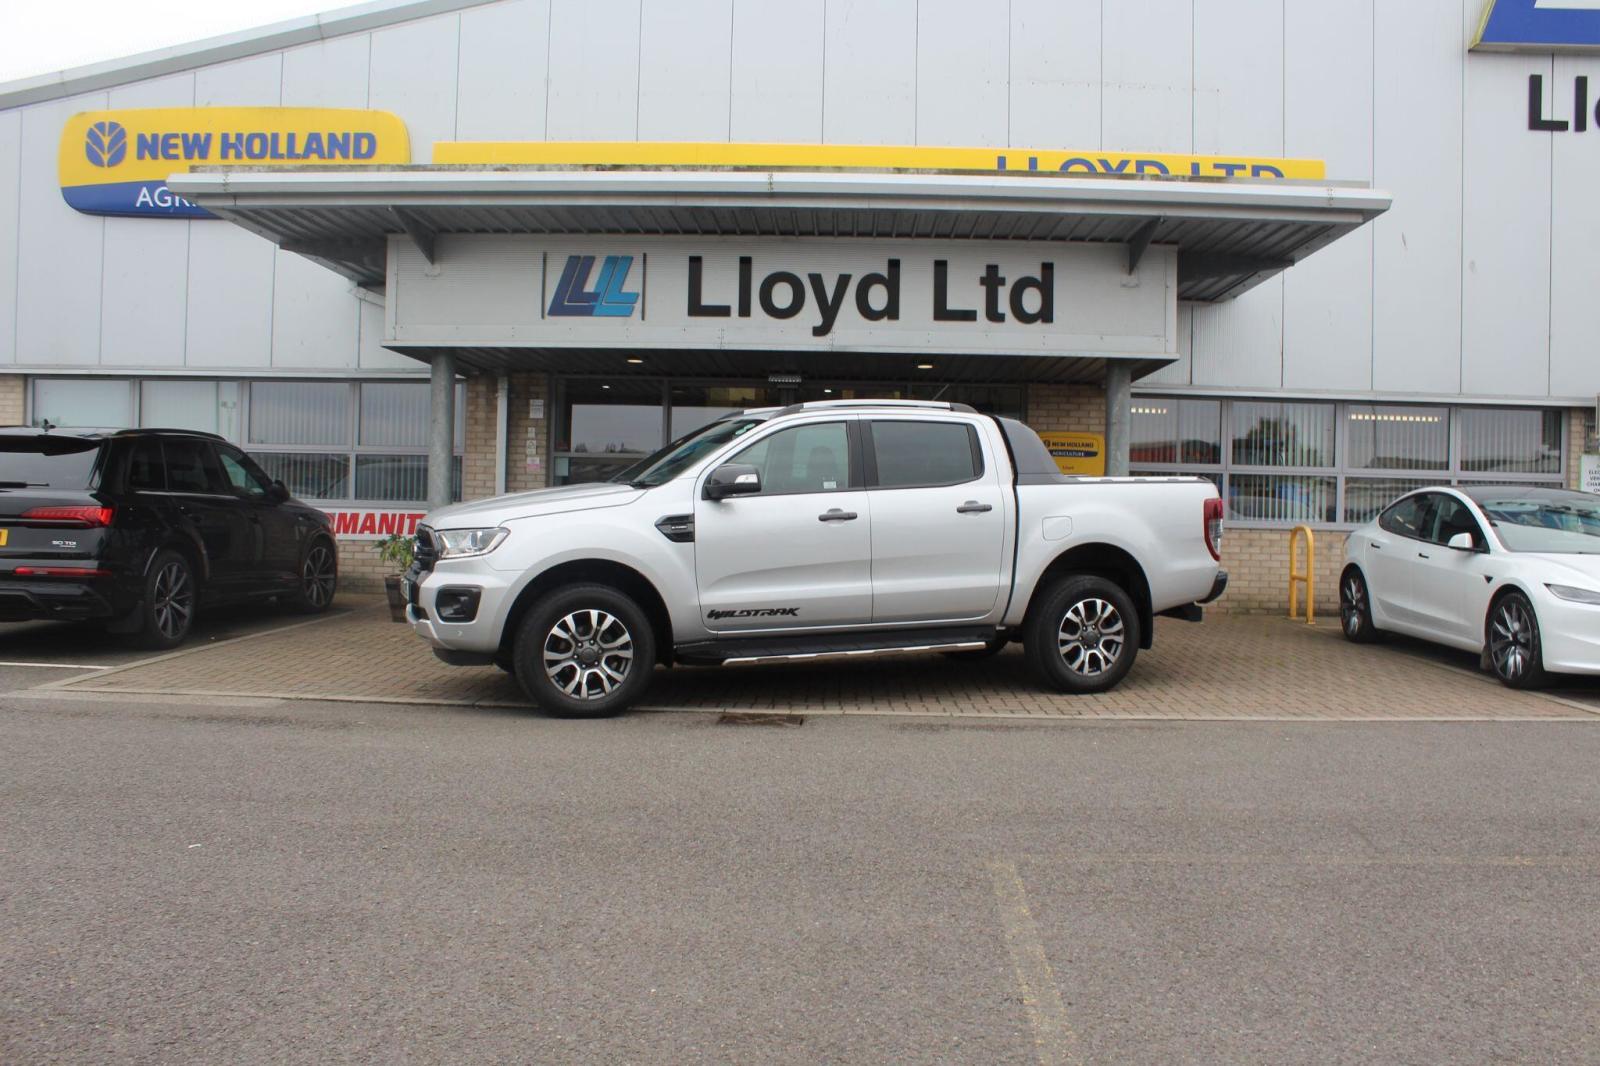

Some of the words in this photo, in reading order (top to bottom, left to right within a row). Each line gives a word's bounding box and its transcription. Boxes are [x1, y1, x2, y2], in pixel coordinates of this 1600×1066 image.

[136, 132, 212, 160] NEW
[220, 132, 377, 160] HOLLAND
[687, 255, 900, 337] Lloyd
[933, 259, 1054, 324] Ltd
